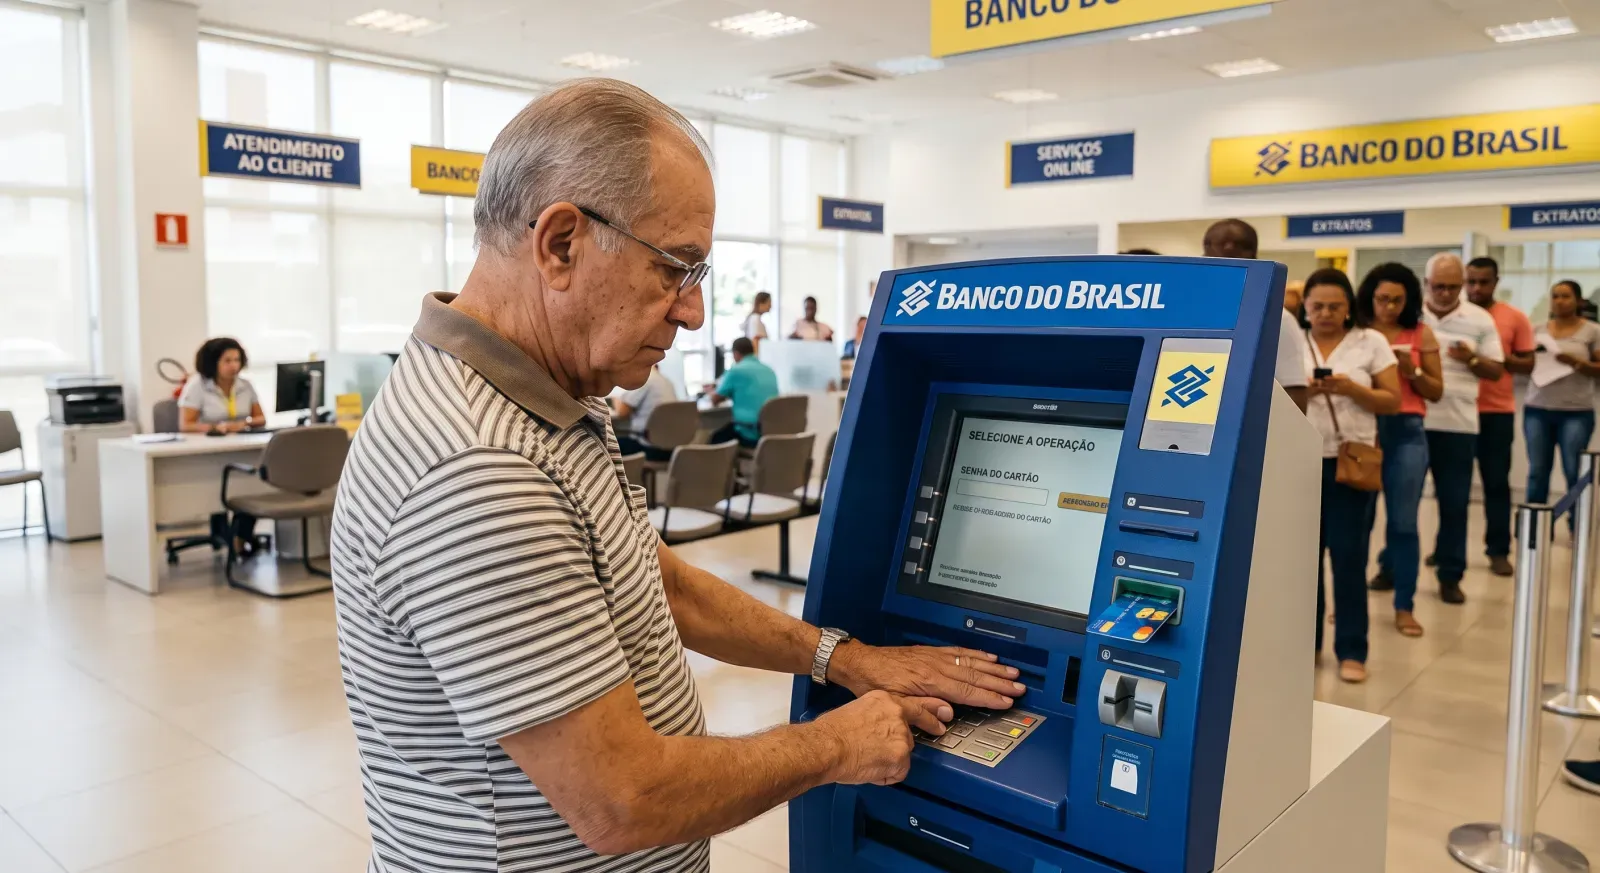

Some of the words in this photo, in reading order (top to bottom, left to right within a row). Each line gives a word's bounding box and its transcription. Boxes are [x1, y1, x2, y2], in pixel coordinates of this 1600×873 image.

[223, 133, 345, 161] ATENDIMENTO
[1037, 140, 1103, 161] SERVIÇOS
[1300, 139, 1398, 168] BANCO
[1404, 136, 1445, 161] DO
[1452, 126, 1568, 157] BRASIL
[238, 154, 263, 172] AO
[267, 157, 333, 179] CLIENTE
[427, 161, 480, 184] BANCO
[1043, 159, 1095, 178] ONLINE
[1311, 218, 1373, 233] EXTRATOS
[936, 283, 1023, 310] BANCO
[1024, 286, 1063, 310] DO
[1065, 280, 1165, 310] BRASIL
[968, 430, 1024, 445] SELECIONE
[1025, 436, 1033, 445] A
[1036, 437, 1095, 453] OPERAÇÃO
[960, 466, 988, 477] SENHA
[989, 469, 1002, 479] DO
[1003, 471, 1039, 483] CARTÃO
[1016, 513, 1026, 521] DO
[1026, 514, 1052, 524] CARTÃO
